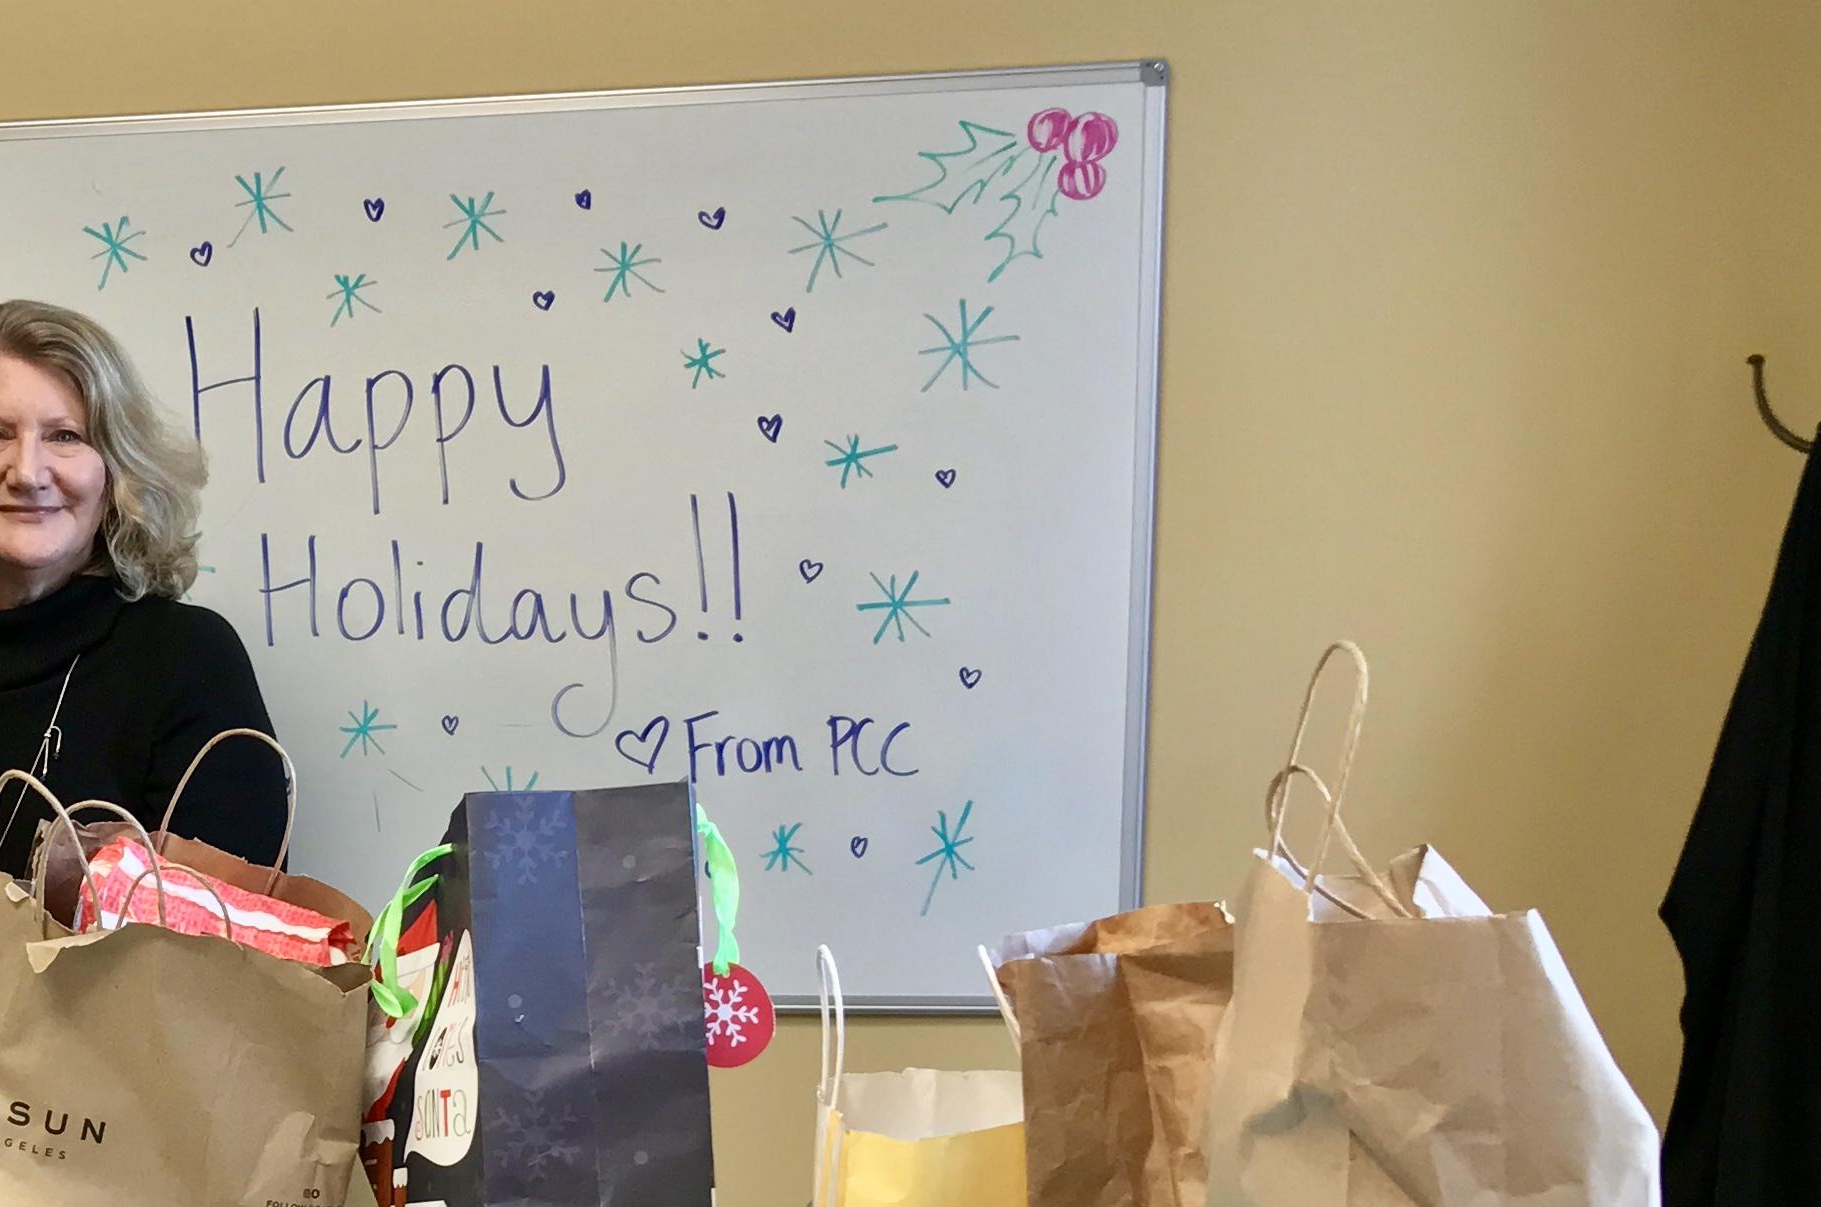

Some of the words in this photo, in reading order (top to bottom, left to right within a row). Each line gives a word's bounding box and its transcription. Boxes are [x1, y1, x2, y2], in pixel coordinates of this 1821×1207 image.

[185, 307, 567, 515] Happy
[259, 491, 745, 738] Holidays!!
[683, 710, 803, 784] From
[826, 715, 920, 776] PCC
